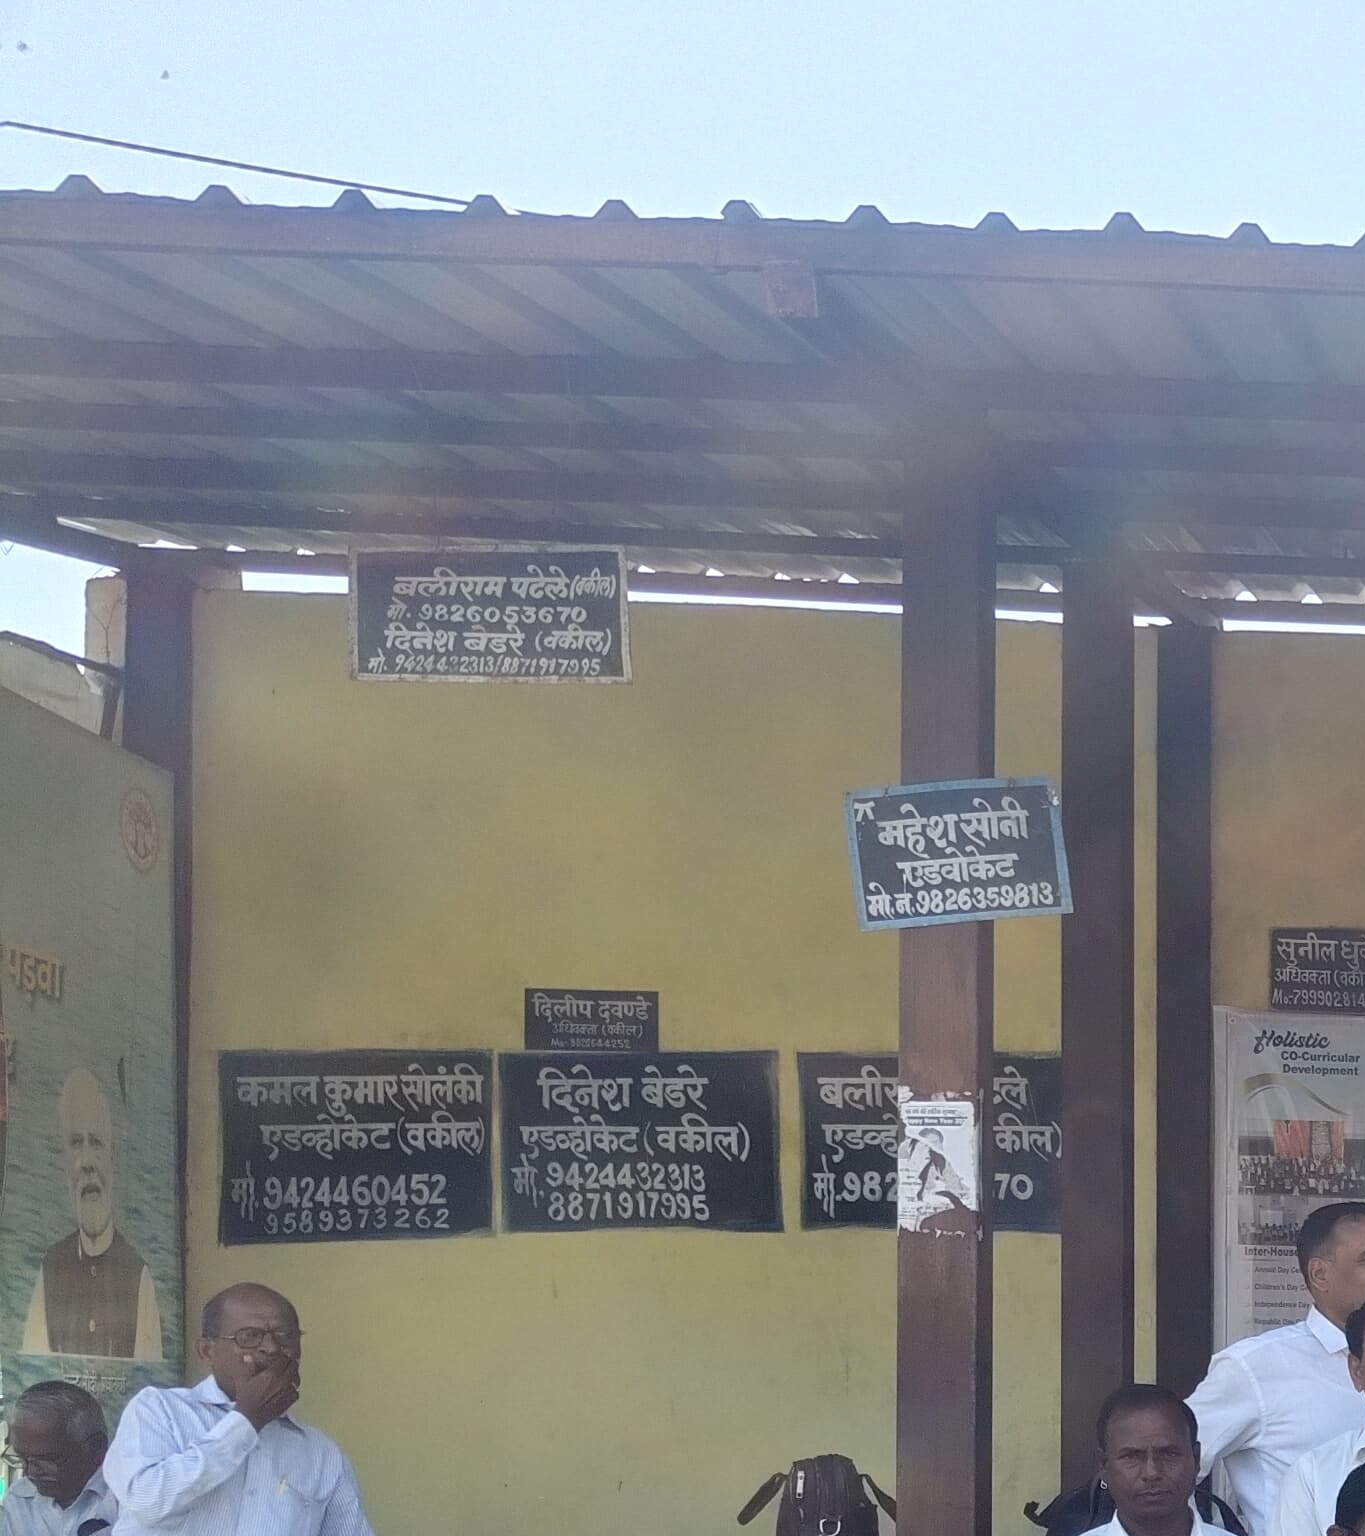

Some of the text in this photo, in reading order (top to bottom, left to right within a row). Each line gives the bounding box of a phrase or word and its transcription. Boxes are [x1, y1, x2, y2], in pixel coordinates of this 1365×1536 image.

[393, 566, 507, 602] बलीराम
[418, 603, 588, 625] 9826053670
[384, 622, 612, 658] दिनेश बेडरे (वकील)
[877, 796, 1030, 859] महेश सोनी
[896, 846, 1019, 887] एडवोकेट
[1277, 932, 1339, 966] सुनील
[1274, 966, 1332, 984] अधिवक्ता
[531, 992, 595, 1022] दिलीप
[1253, 1029, 1330, 1055] Holistic
[1280, 1050, 1361, 1063] CO-Curricular
[816, 1065, 1029, 1110] बलीर ले
[1282, 1063, 1359, 1077] Development
[237, 1063, 484, 1117] कमल कुमार सोलंकी
[536, 1064, 710, 1114] दिनेश बेडरे
[259, 1110, 485, 1161] एडव्होकेट (वकील)
[519, 1112, 751, 1163] एडव्होकेट (वकील)
[822, 1112, 1063, 1164] एडव्ह कील)
[264, 1173, 448, 1210] 9424460452
[545, 1161, 706, 1192] 9424432313
[993, 1173, 1034, 1200] 70
[263, 1208, 450, 1234] 9589373262
[548, 1191, 710, 1222] 8871917995
